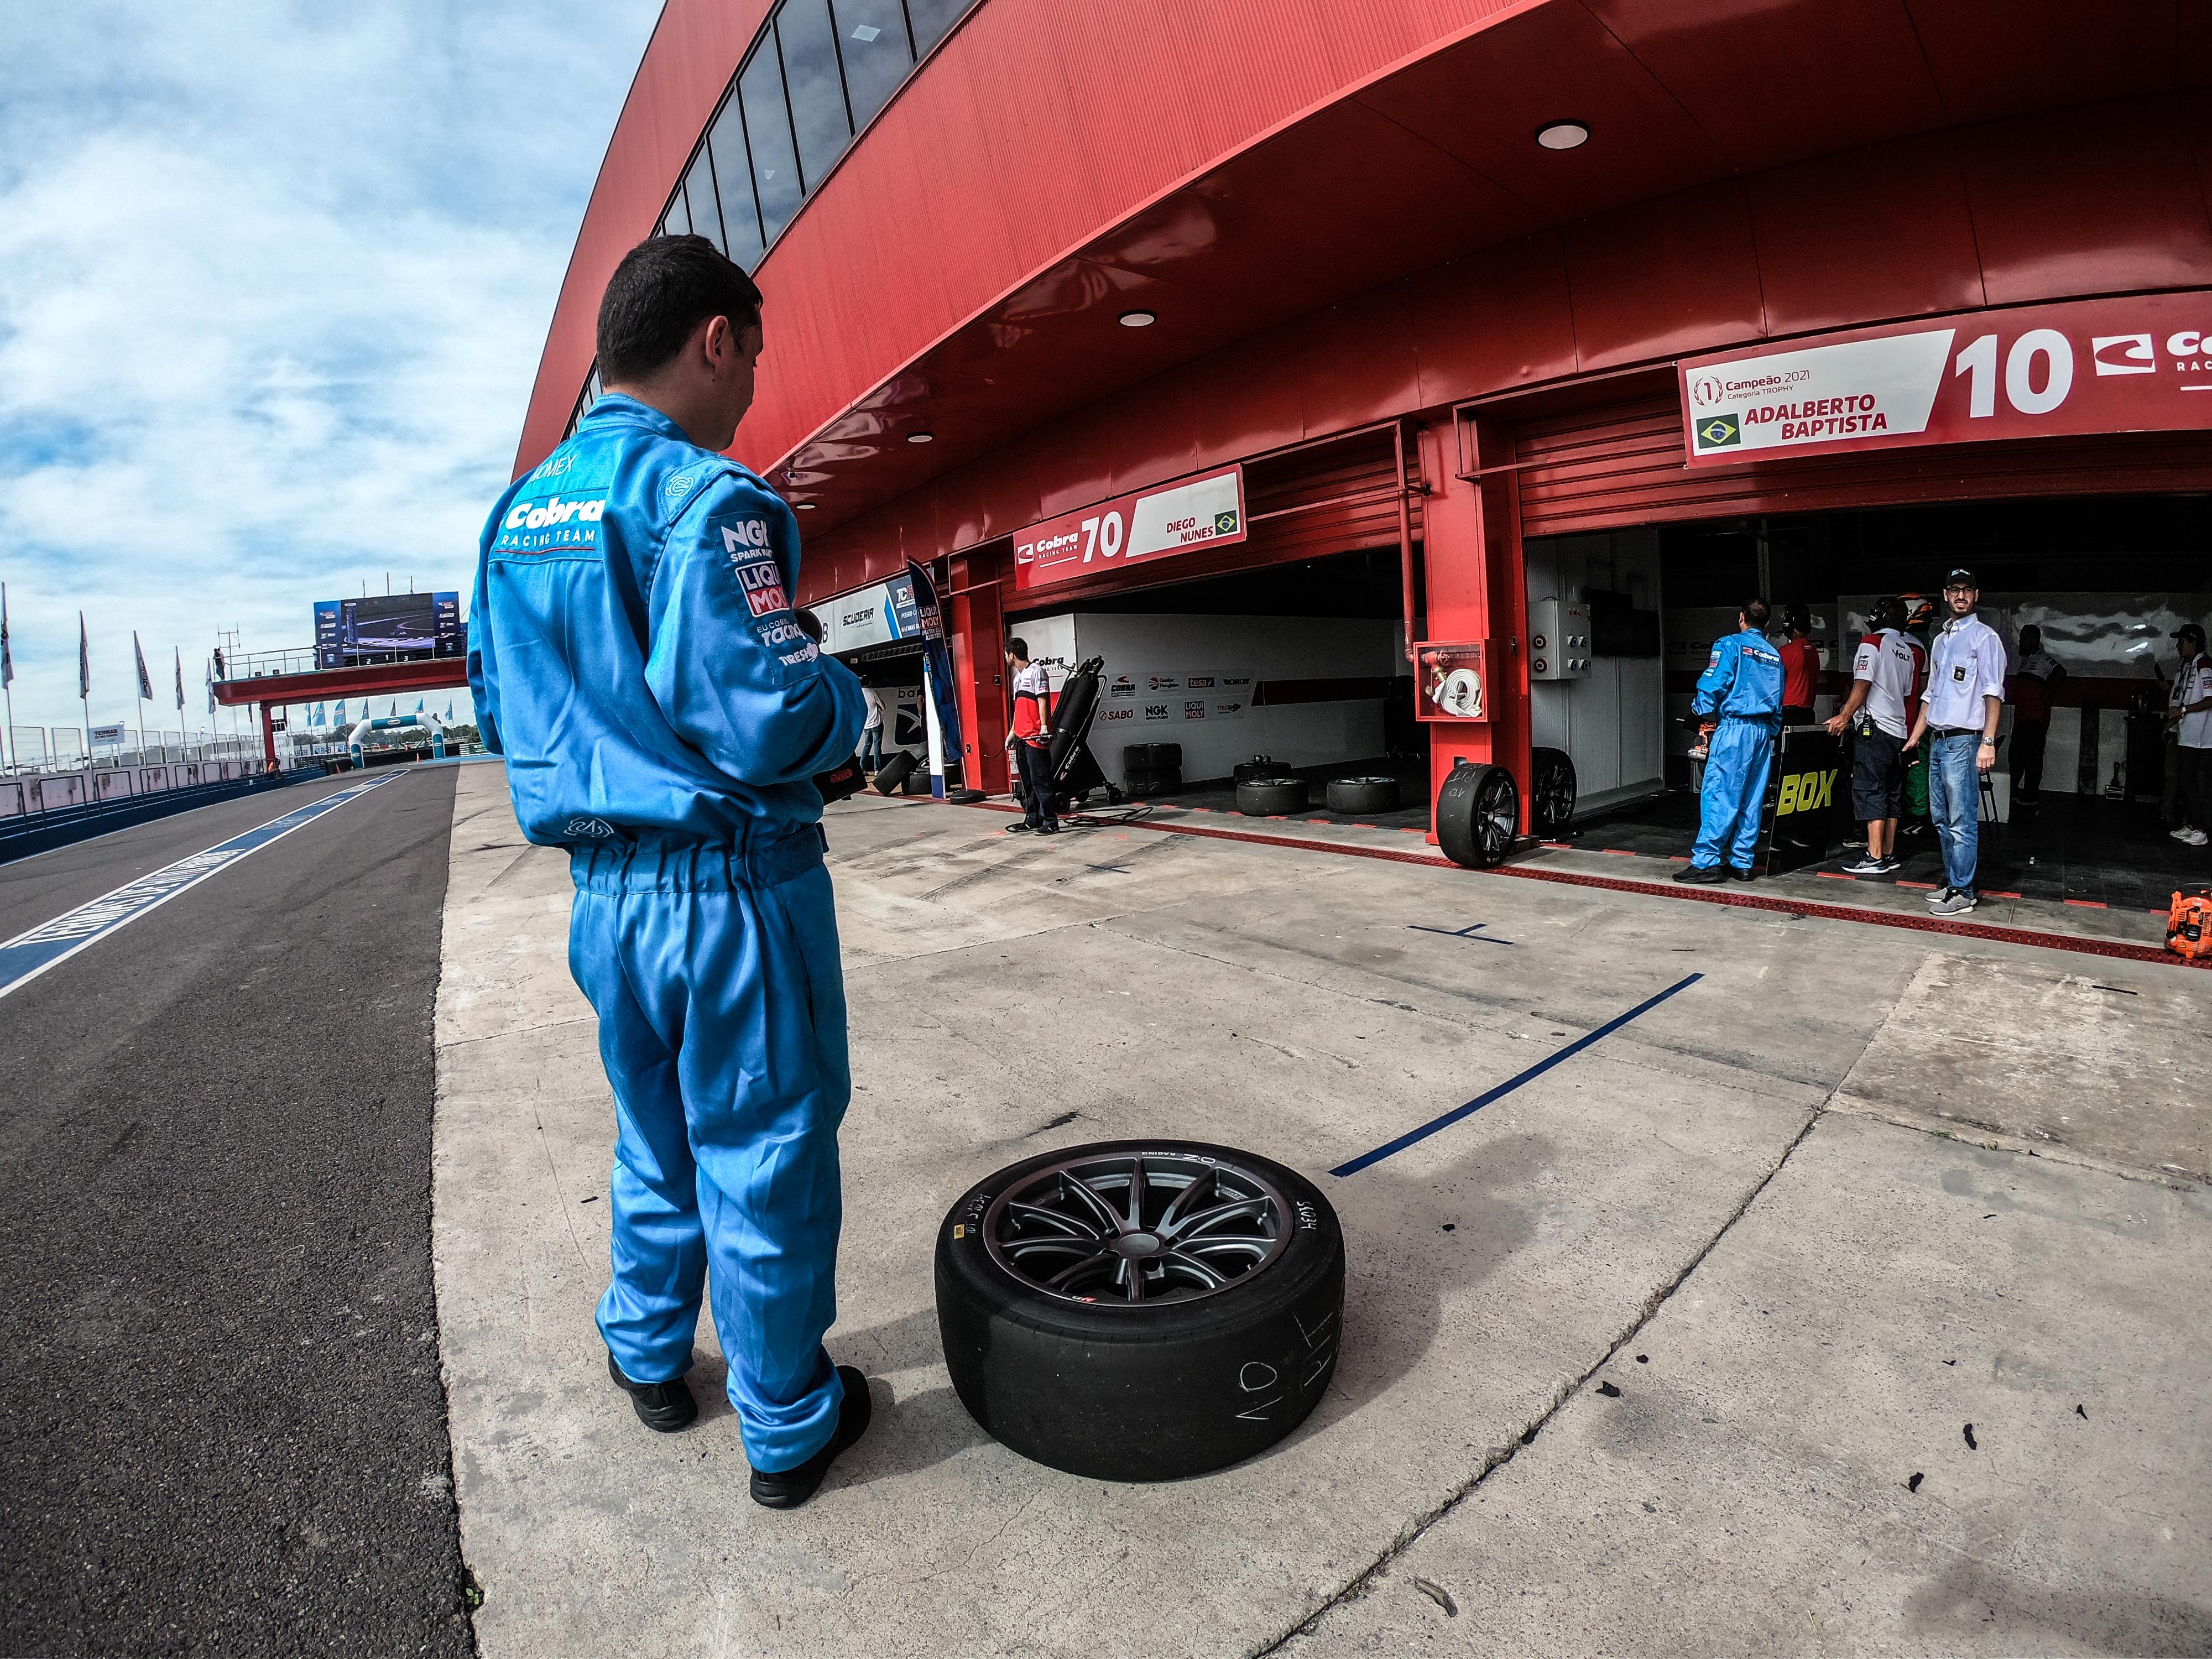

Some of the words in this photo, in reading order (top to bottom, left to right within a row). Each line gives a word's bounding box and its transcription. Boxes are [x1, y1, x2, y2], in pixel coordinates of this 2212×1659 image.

[1726, 375, 1781, 391] Campeão
[1785, 370, 1810, 383] 2021
[1955, 329, 2073, 418] 10
[1761, 385, 1793, 395] TROPHY
[1744, 394, 1876, 425] ADALBERTO
[1781, 413, 1887, 440] BAPTISTA
[529, 454, 577, 484] NOMEX
[505, 497, 606, 529] Cobra
[1166, 517, 1196, 534] DIEGO
[500, 533, 550, 547] RACING
[556, 529, 595, 542] TEAM
[1036, 532, 1078, 552] Cobra
[1082, 511, 1123, 564] 70
[1180, 526, 1213, 543] NUNES
[731, 547, 761, 562] SPARK
[1039, 549, 1060, 559] RACING
[1062, 545, 1078, 553] TEAM
[843, 607, 874, 626] SCUDERIA
[919, 606, 937, 617] LIQUI
[921, 617, 939, 628] MOLY
[1032, 656, 1065, 666] Cobra
[1190, 679, 1207, 687] tesa
[898, 688, 919, 698] ba
[1145, 705, 1168, 717] NGK
[1185, 702, 1203, 710] LIQUI
[1185, 710, 1204, 719] MOLY
[1065, 746, 1079, 770] Cobra
[1776, 769, 1838, 816] BOX
